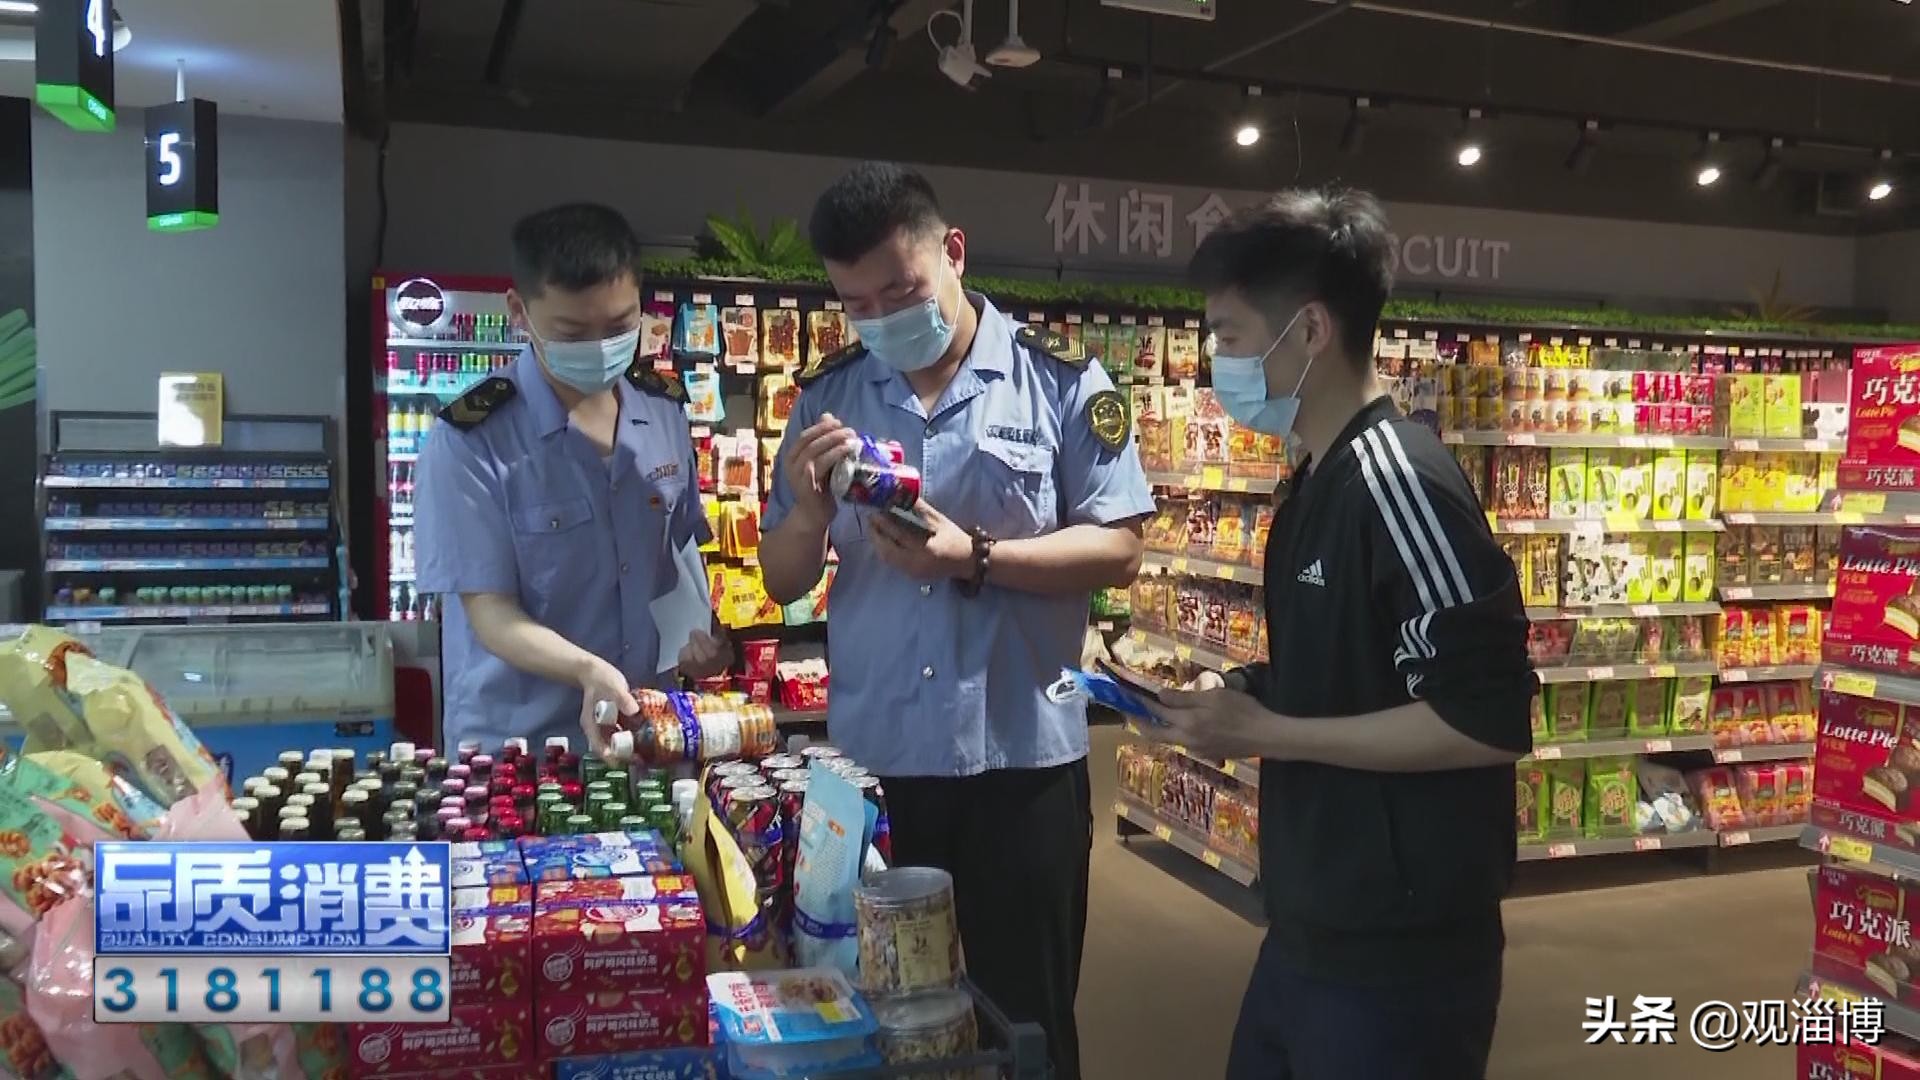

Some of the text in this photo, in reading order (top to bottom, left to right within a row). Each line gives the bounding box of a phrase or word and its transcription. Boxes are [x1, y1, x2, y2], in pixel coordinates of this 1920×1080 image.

[87, 0, 105, 57] 4
[159, 132, 181, 186] 5
[1842, 554, 1891, 574] Lotte
[1850, 644, 1899, 666] 巧克派
[1822, 719, 1898, 749] Lotte Pie
[1829, 900, 1911, 949] 巧克派
